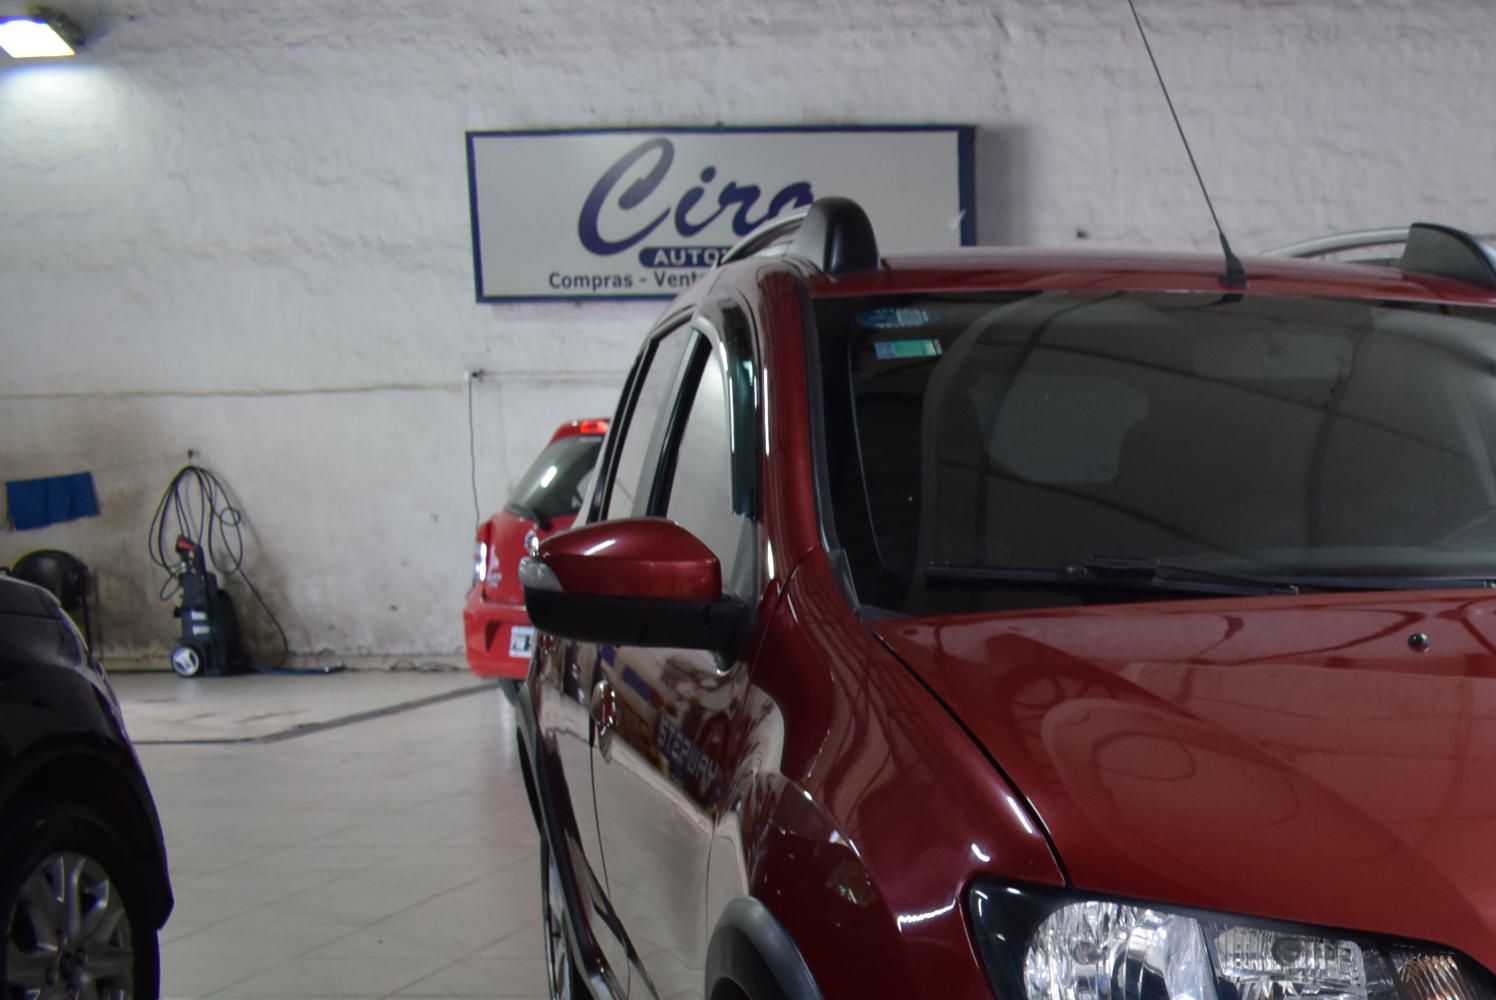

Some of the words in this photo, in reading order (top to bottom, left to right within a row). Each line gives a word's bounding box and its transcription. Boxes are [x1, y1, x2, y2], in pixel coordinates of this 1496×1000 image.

[653, 247, 728, 267] AUTO
[549, 271, 634, 291] Compras
[654, 270, 705, 288] Vent
